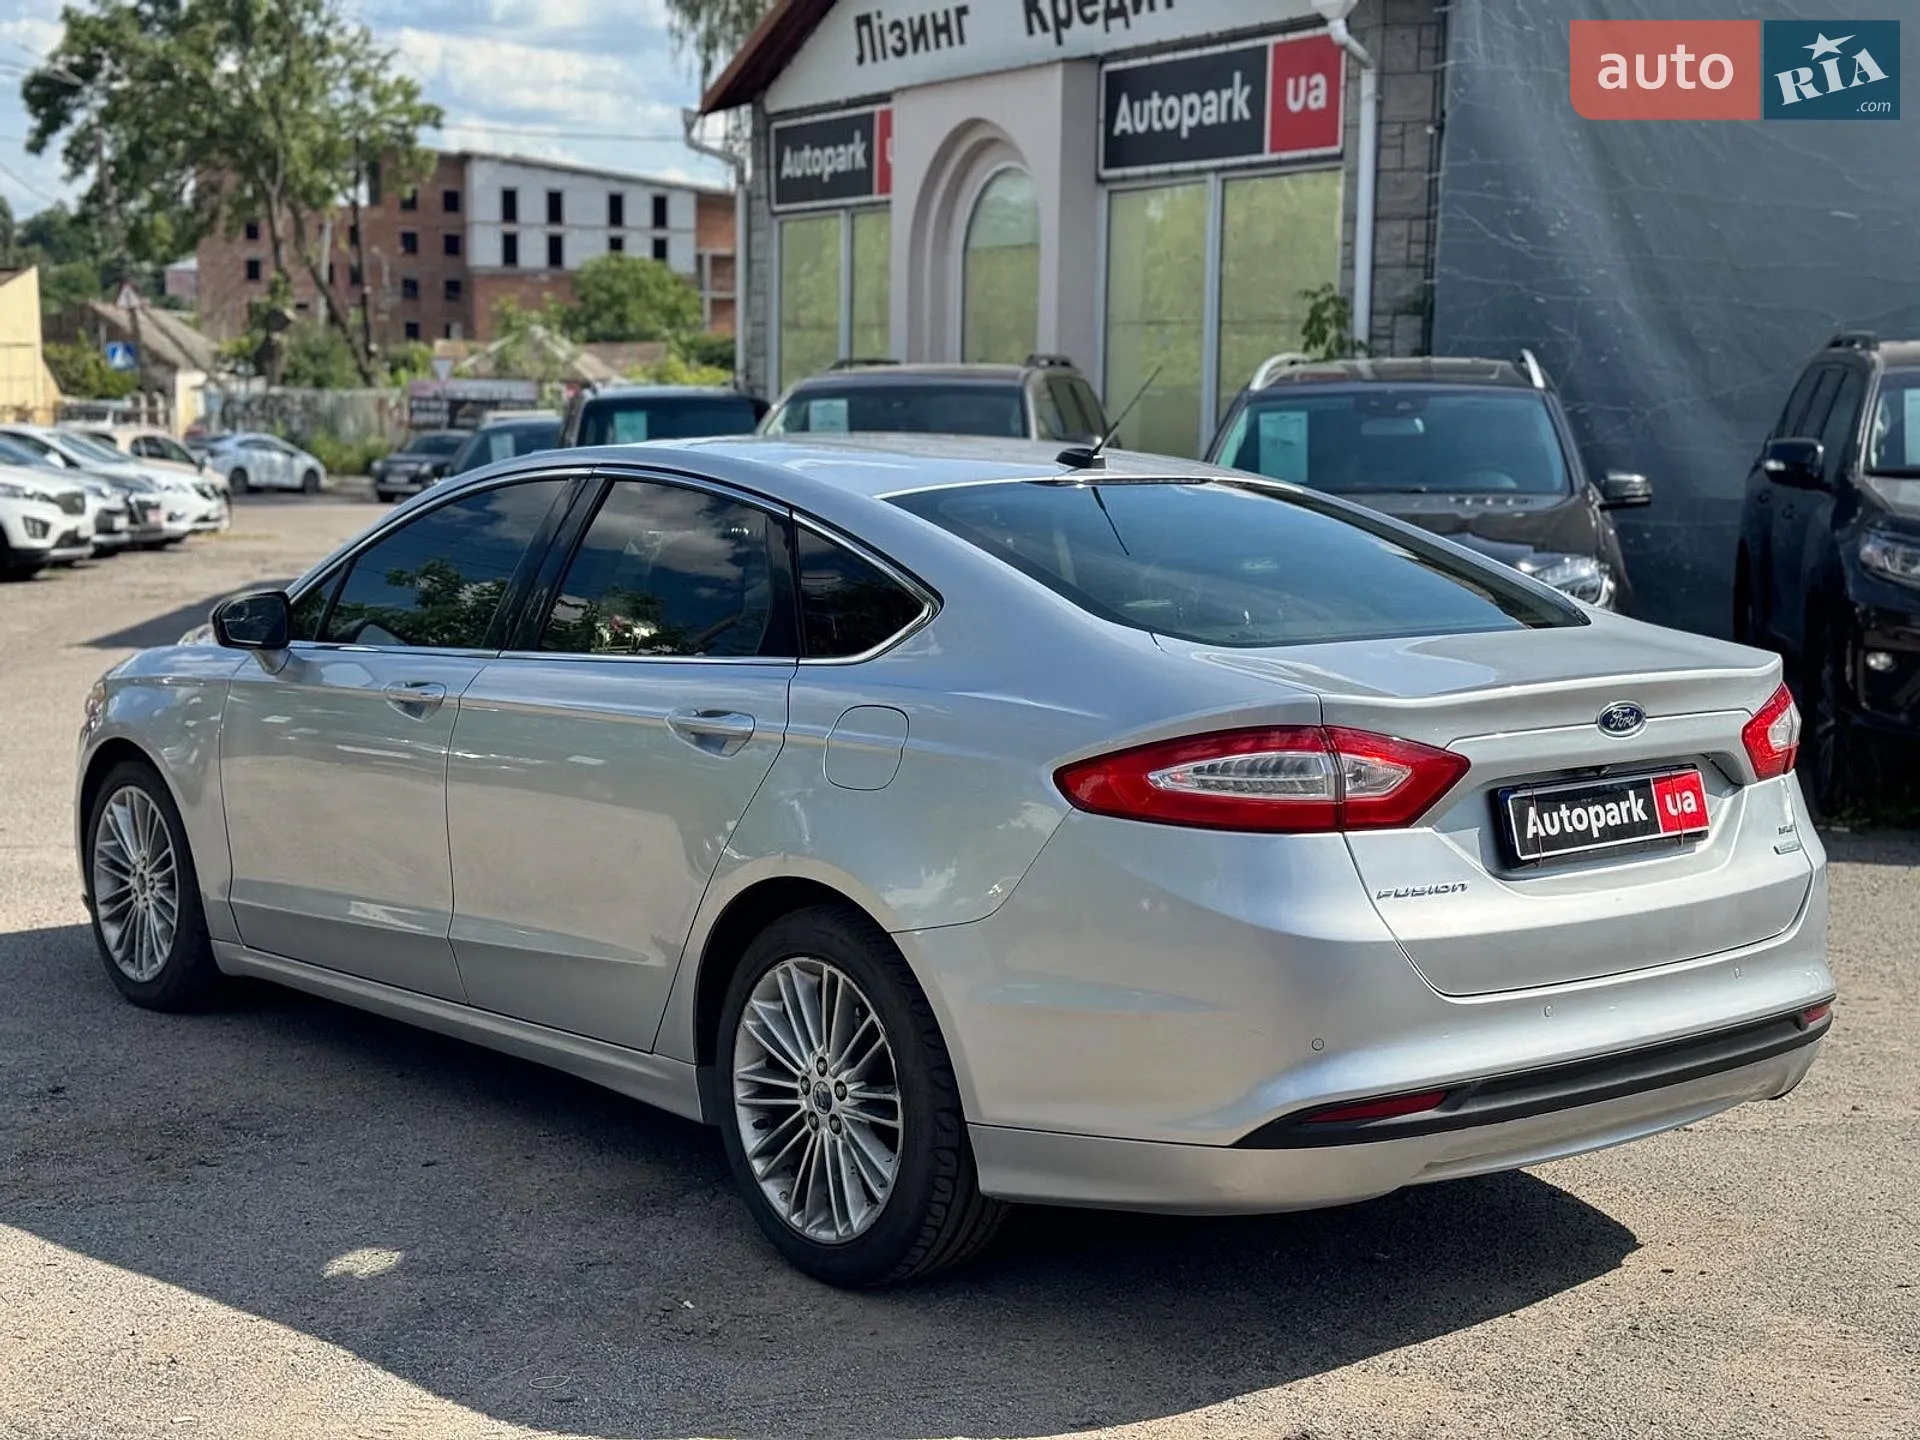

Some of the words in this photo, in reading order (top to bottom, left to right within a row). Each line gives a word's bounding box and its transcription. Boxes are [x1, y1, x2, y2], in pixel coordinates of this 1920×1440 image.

[855, 5, 970, 66] Лізинг
[1113, 70, 1251, 139] Autopark
[1286, 72, 1327, 112] ua
[781, 130, 867, 183] Autopark
[1609, 708, 1637, 729] Ford
[1526, 790, 1648, 839] Autopark
[1664, 789, 1698, 817] ua
